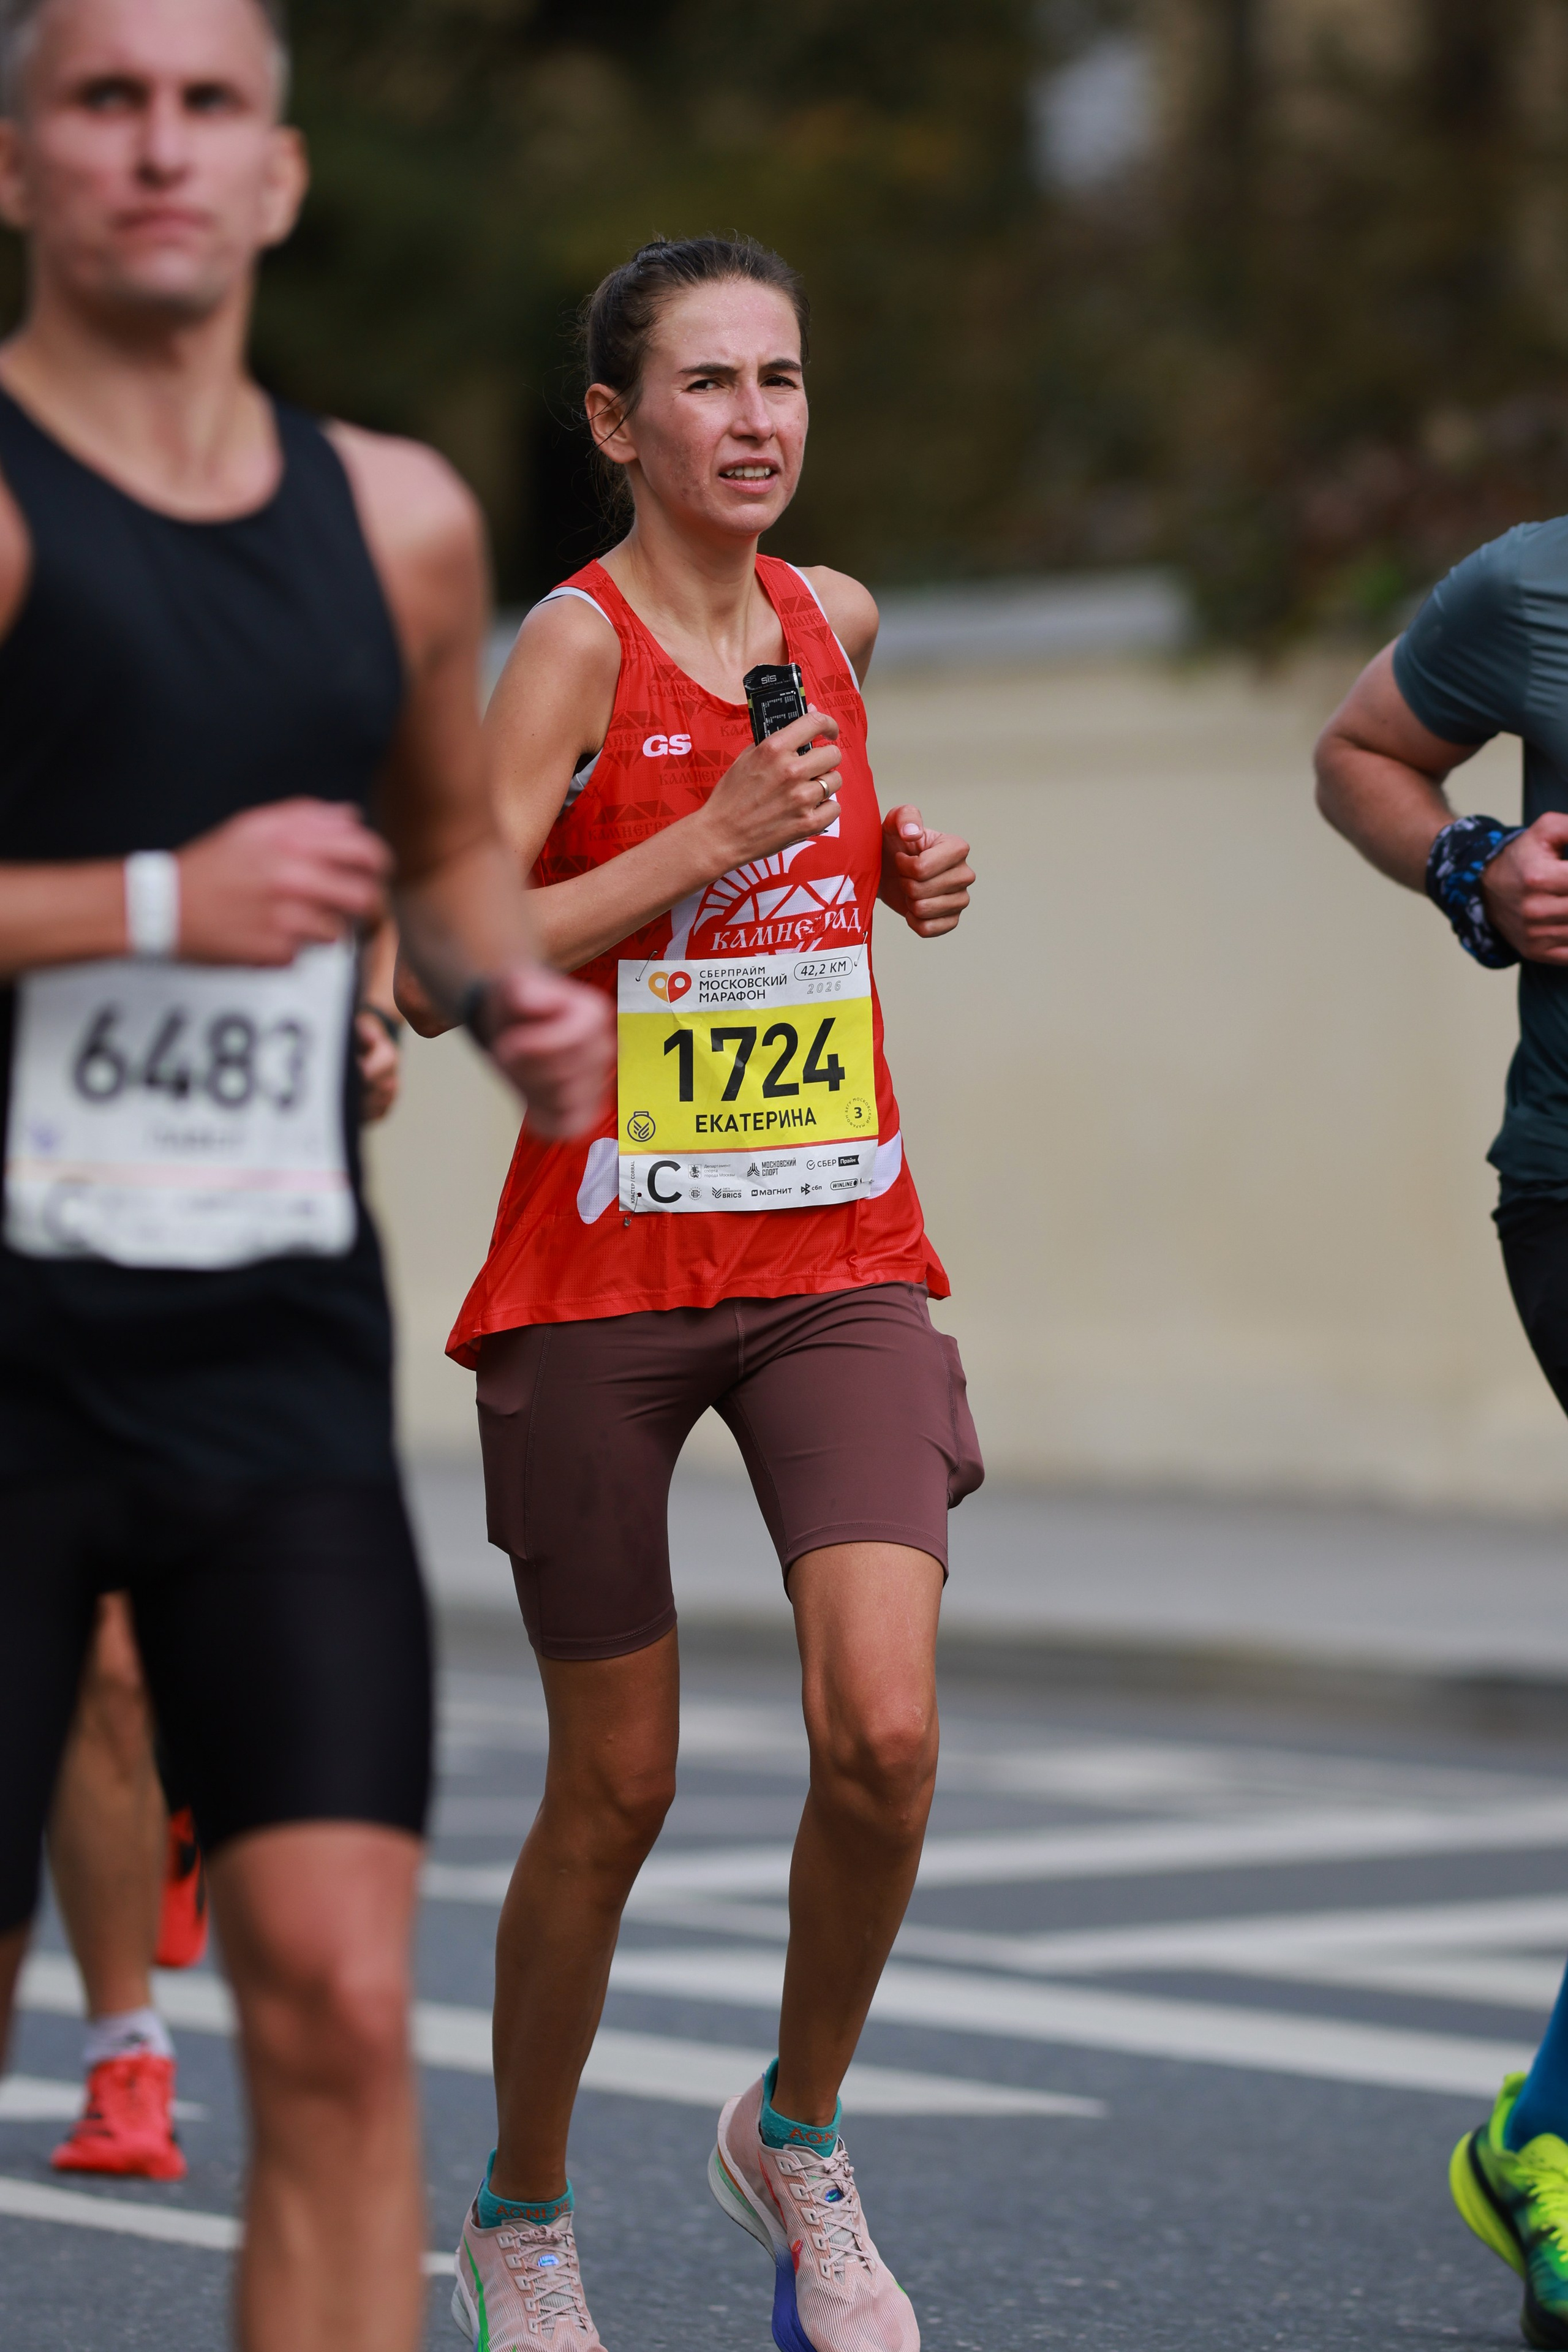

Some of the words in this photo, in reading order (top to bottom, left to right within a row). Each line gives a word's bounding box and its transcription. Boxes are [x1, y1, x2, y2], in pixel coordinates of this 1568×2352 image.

[642, 733, 692, 758] GS
[699, 966, 766, 978] СБЕРПРАЙМ
[801, 963, 826, 977] 42,2
[829, 960, 846, 973] КМ
[699, 973, 788, 991] МОСКОВСКИЙ
[807, 981, 842, 995] 2026
[699, 989, 766, 1003] МАРАФОН
[72, 1001, 307, 1112] 6483
[663, 1017, 846, 1102] 1724
[695, 1107, 817, 1133] ЕКАТЕРИНА
[854, 1106, 863, 1119] 3
[761, 1158, 797, 1169] МОСКОВСКИЙ
[817, 1159, 837, 1167] СБЕР
